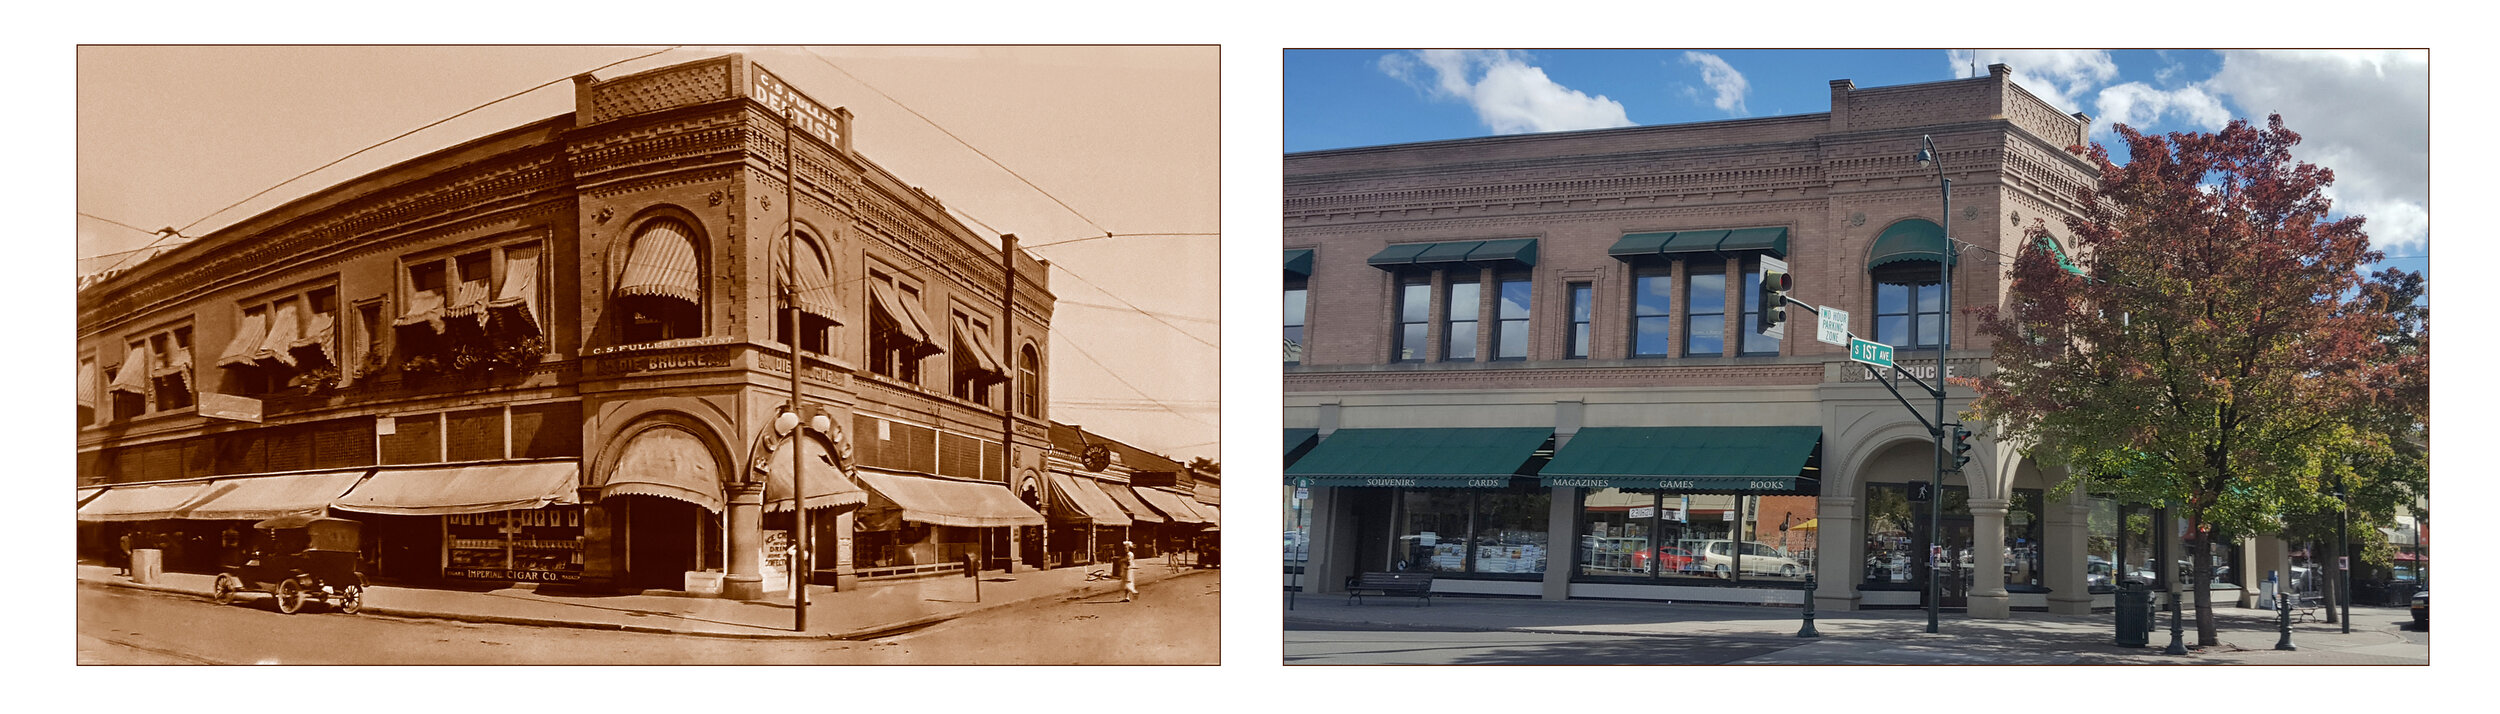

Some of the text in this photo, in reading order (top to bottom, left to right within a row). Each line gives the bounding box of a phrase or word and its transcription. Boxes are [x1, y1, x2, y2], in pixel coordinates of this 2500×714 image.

[755, 84, 840, 147] DENTIST
[1820, 308, 1847, 323] TWO HOUR
[1822, 319, 1843, 333] PARKING
[677, 336, 734, 347] DENTIST
[1825, 330, 1839, 342] ZONE
[1854, 343, 1890, 361] S 1ST AVE
[1367, 478, 1499, 487] SOUVENIRS CARDS
[1552, 478, 1784, 489] MAGAZINES GAMES BOOKS
[468, 569, 503, 579] IMPERIAL
[507, 570, 538, 580] CIGAR
[542, 571, 559, 581] CO.
